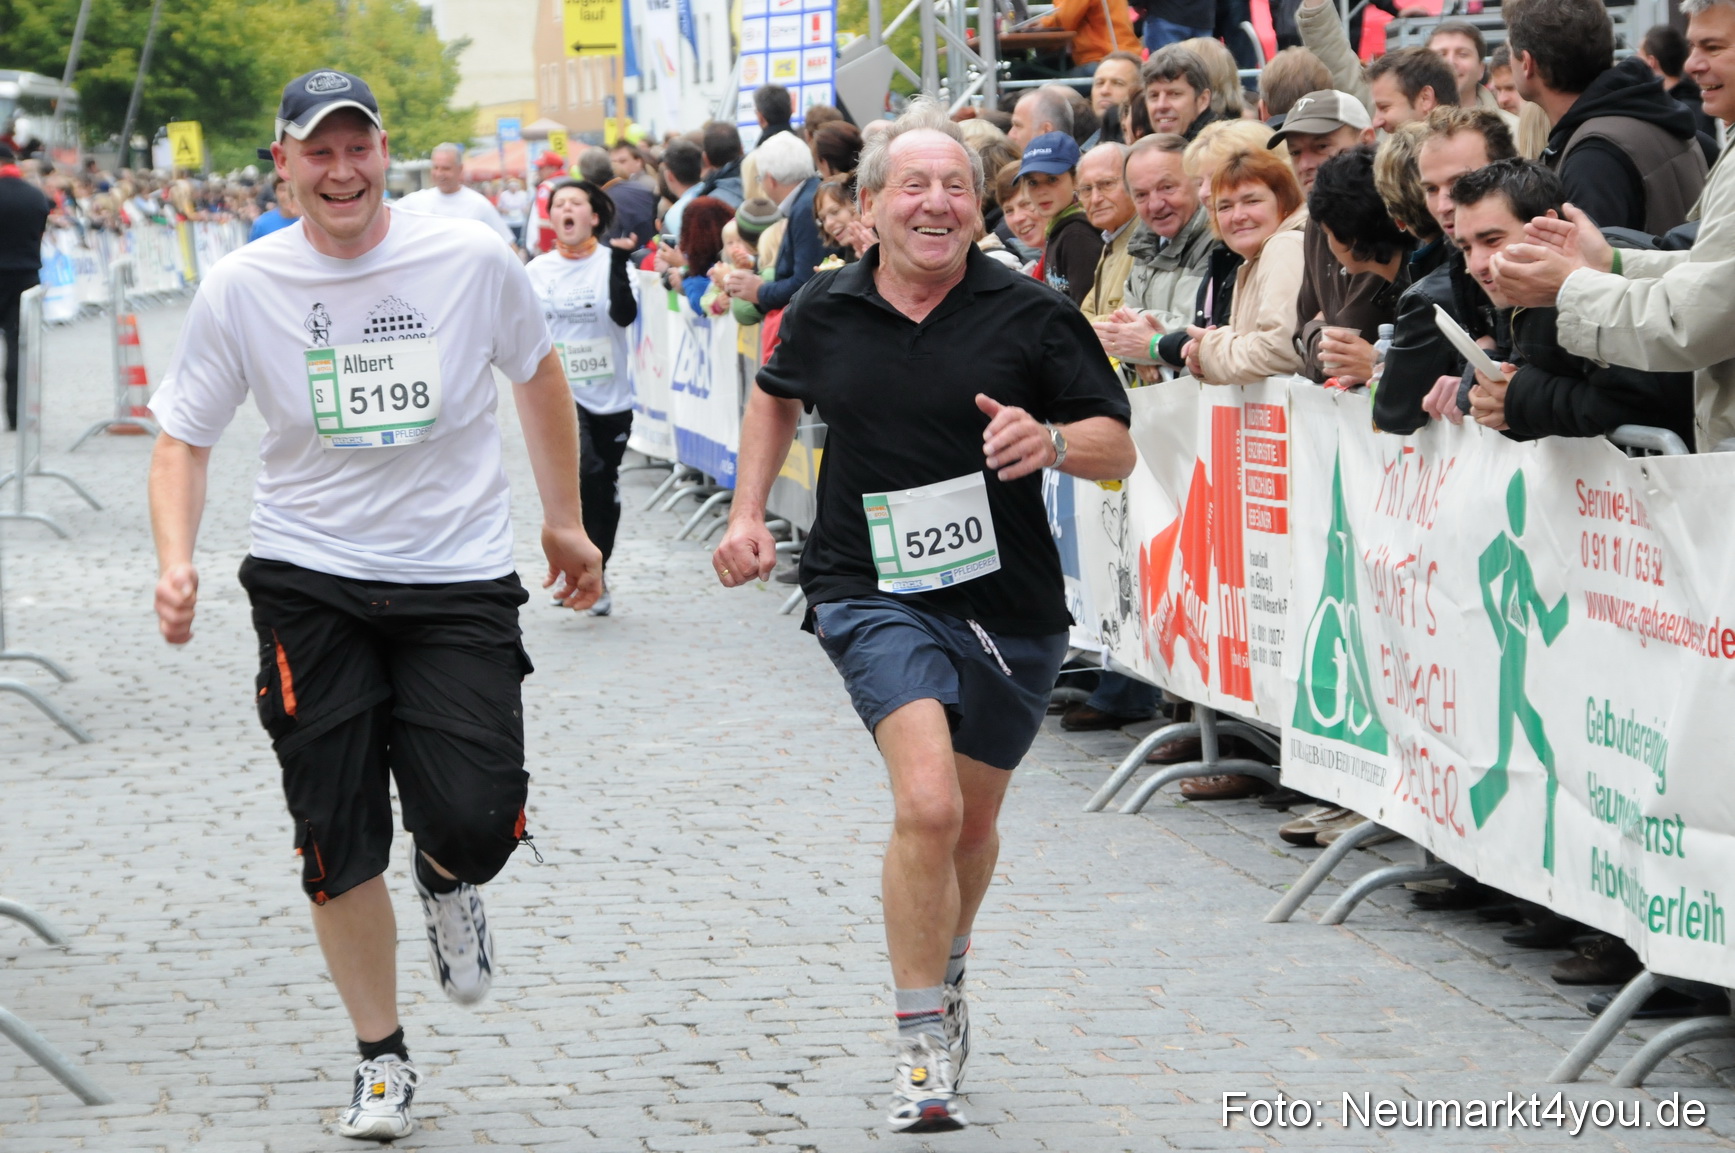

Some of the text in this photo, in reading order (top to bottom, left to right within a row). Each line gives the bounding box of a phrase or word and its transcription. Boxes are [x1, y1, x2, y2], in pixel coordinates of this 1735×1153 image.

[580, 7, 606, 20] lauf
[176, 135, 192, 155] A
[343, 354, 394, 374] Albert
[570, 356, 608, 373] 5094
[315, 388, 324, 403] S
[349, 381, 430, 415] 5198
[906, 516, 983, 559] 5230
[953, 557, 997, 577] PFLEIDERER
